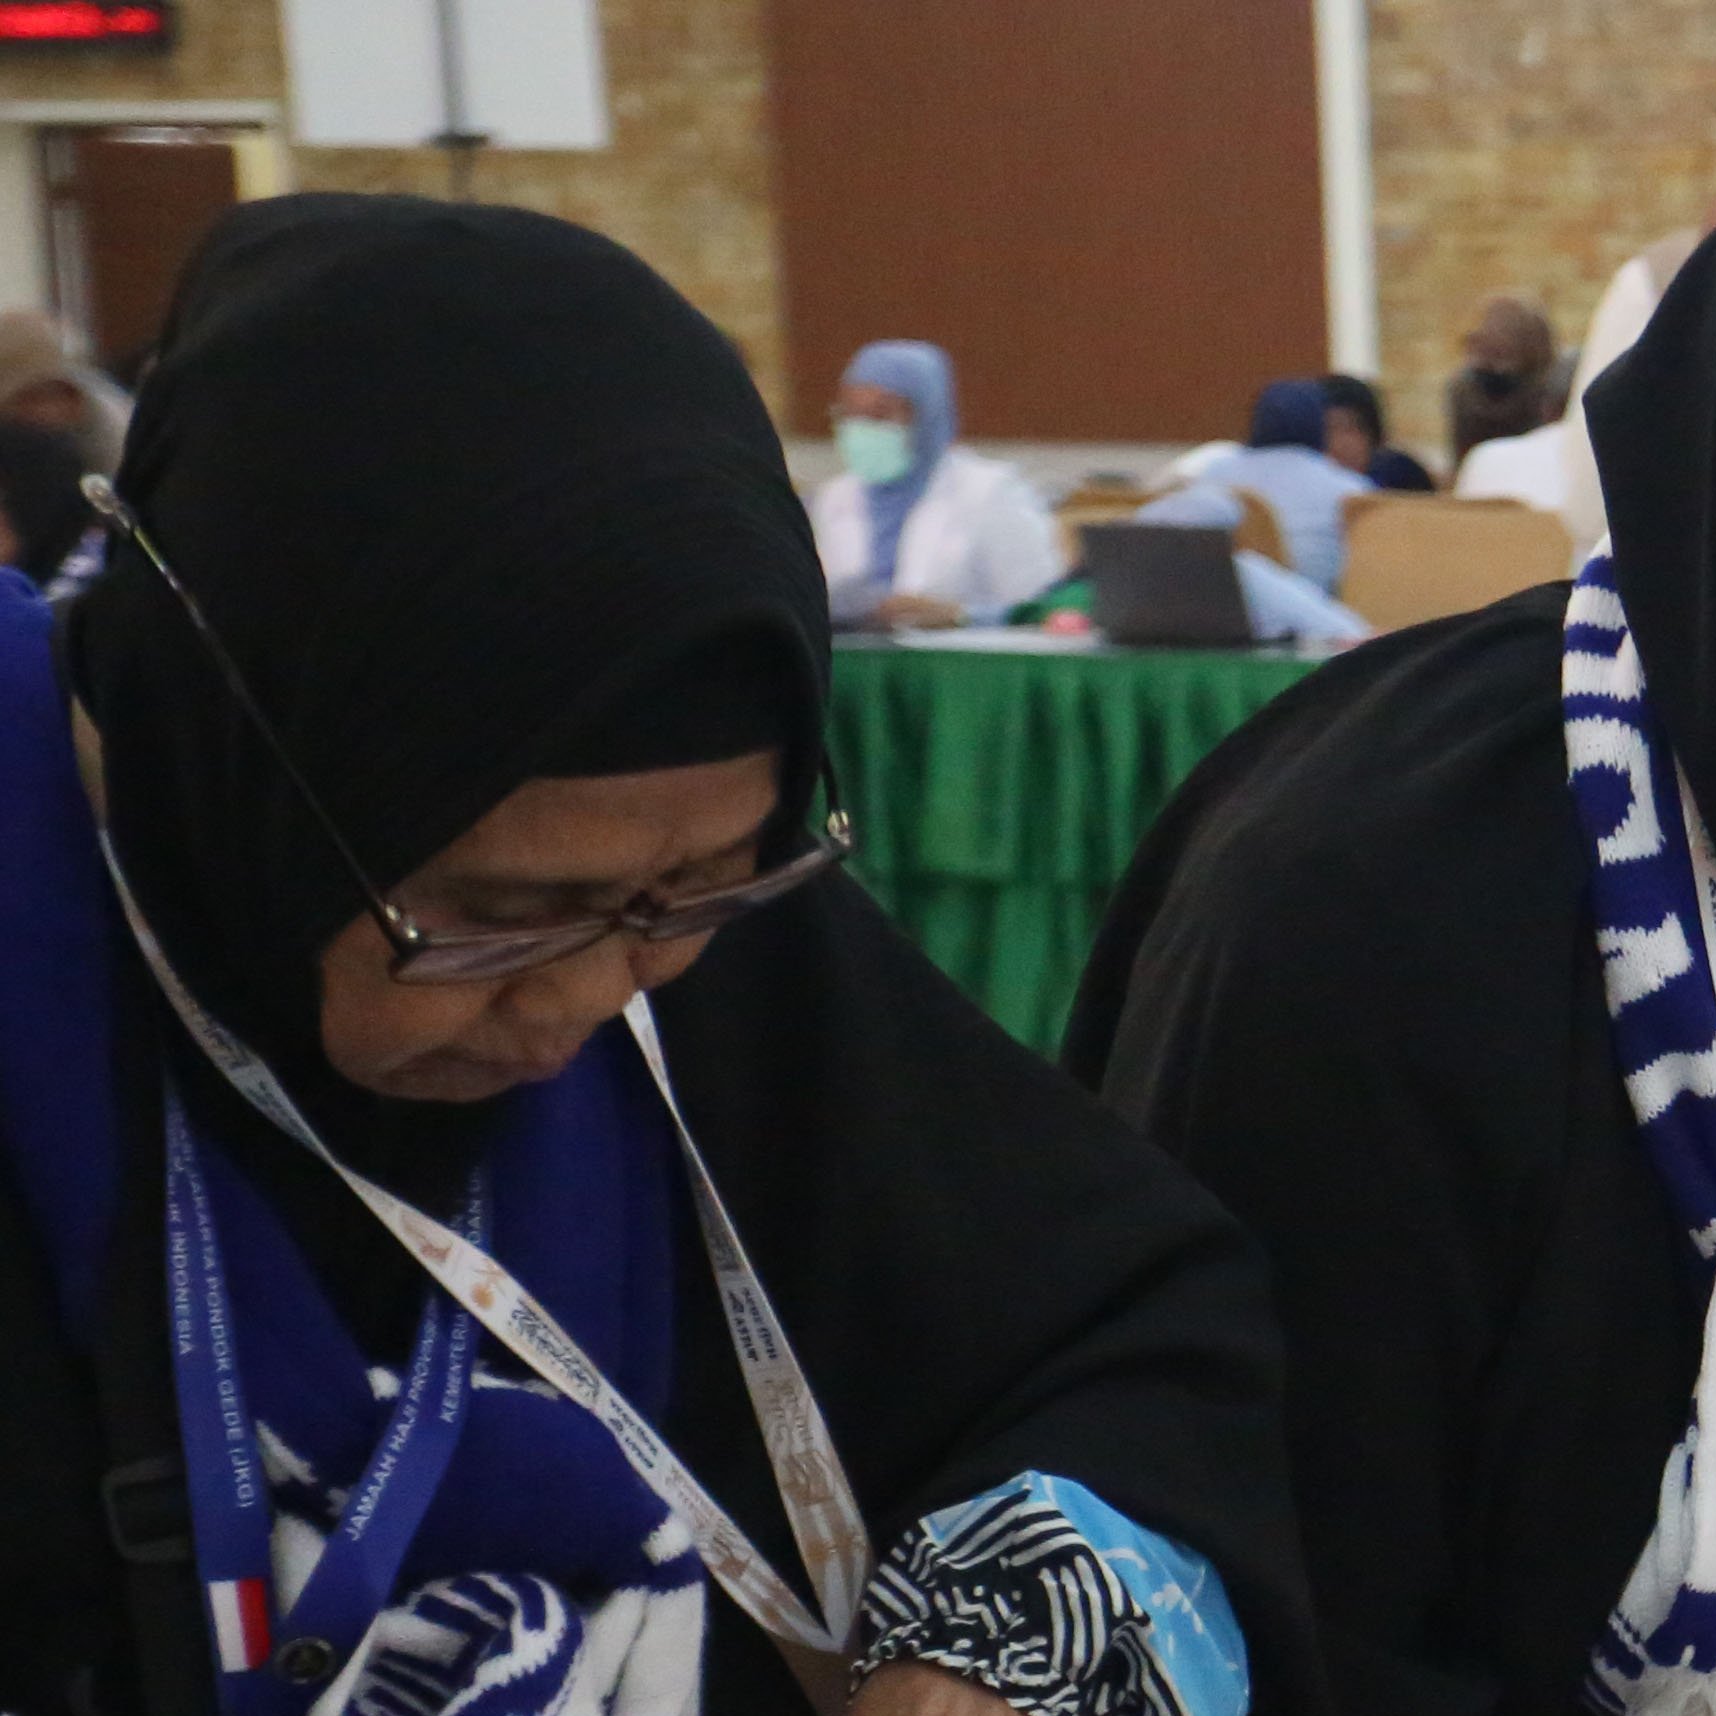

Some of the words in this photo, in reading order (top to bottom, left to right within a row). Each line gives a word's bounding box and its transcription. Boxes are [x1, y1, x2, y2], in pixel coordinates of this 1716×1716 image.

[206, 1276, 232, 1374] PONDOK
[217, 1379, 245, 1442] GEDE
[228, 1447, 256, 1508] (JKG)
[346, 1454, 398, 1541] JAMAAH
[388, 1405, 418, 1453] HAJI
